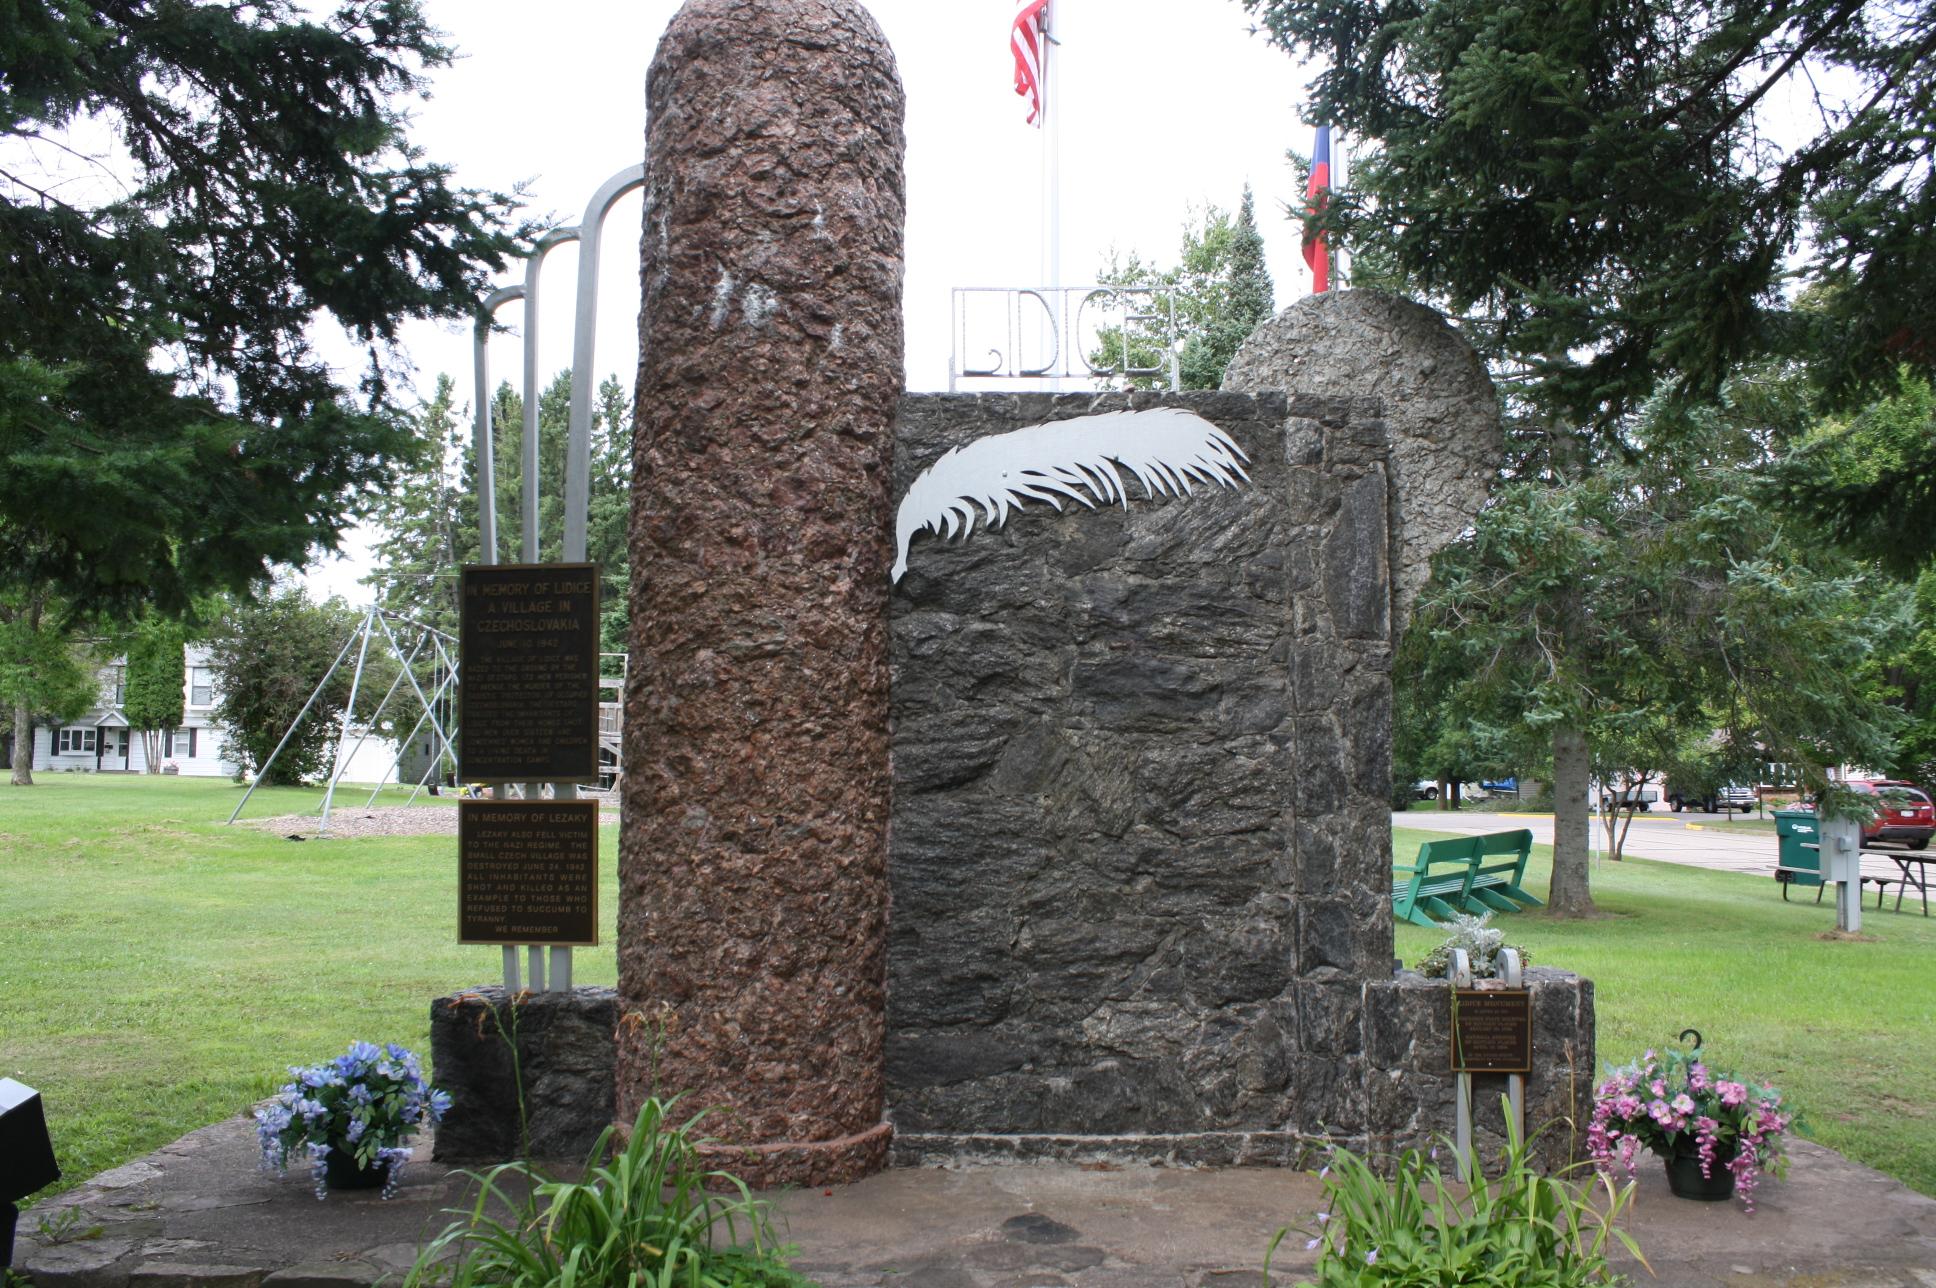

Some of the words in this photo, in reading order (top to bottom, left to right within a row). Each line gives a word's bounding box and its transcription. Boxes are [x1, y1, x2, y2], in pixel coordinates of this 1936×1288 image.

[963, 288, 1165, 377] LIDICE
[466, 584, 477, 596] IN
[483, 583, 530, 596] MEMORY
[534, 582, 551, 595] OF
[554, 581, 591, 594] LIDICE
[488, 602, 496, 613] A
[502, 600, 553, 613] VILLAGE
[559, 600, 570, 612] IN
[477, 618, 580, 632] CZECHOSLOVAKIA
[467, 813, 479, 822] IN
[482, 813, 527, 822] MEMORY
[531, 813, 545, 822] OF
[549, 813, 588, 822] LEZAKY
[476, 831, 508, 839] LEZAKY
[511, 831, 533, 839] ALSO
[536, 831, 556, 839] FELL
[559, 831, 588, 839] VICTIM
[467, 841, 480, 849] TO
[483, 841, 500, 849] THE
[503, 841, 523, 849] NAZI
[570, 841, 587, 849] THE
[467, 852, 496, 860] SMALL
[498, 852, 527, 860] CZECH
[530, 852, 565, 860] VILLAGE
[568, 852, 588, 860] WAS
[467, 862, 519, 870] DESTROYED
[523, 862, 545, 870] JUNE
[467, 873, 484, 881] ALL
[489, 873, 554, 881] INHABITANTS
[560, 873, 587, 881] WERE
[467, 883, 492, 891] SHOT
[496, 883, 516, 891] AND
[520, 883, 553, 891] KILLED
[558, 883, 570, 891] AS
[574, 883, 587, 891] AN
[467, 894, 509, 902] EXAMPLE
[514, 894, 526, 902] TO
[531, 894, 561, 902] THOSE
[566, 894, 587, 902] WHO
[496, 926, 508, 934] WE
[511, 926, 558, 934] REMEMBER
